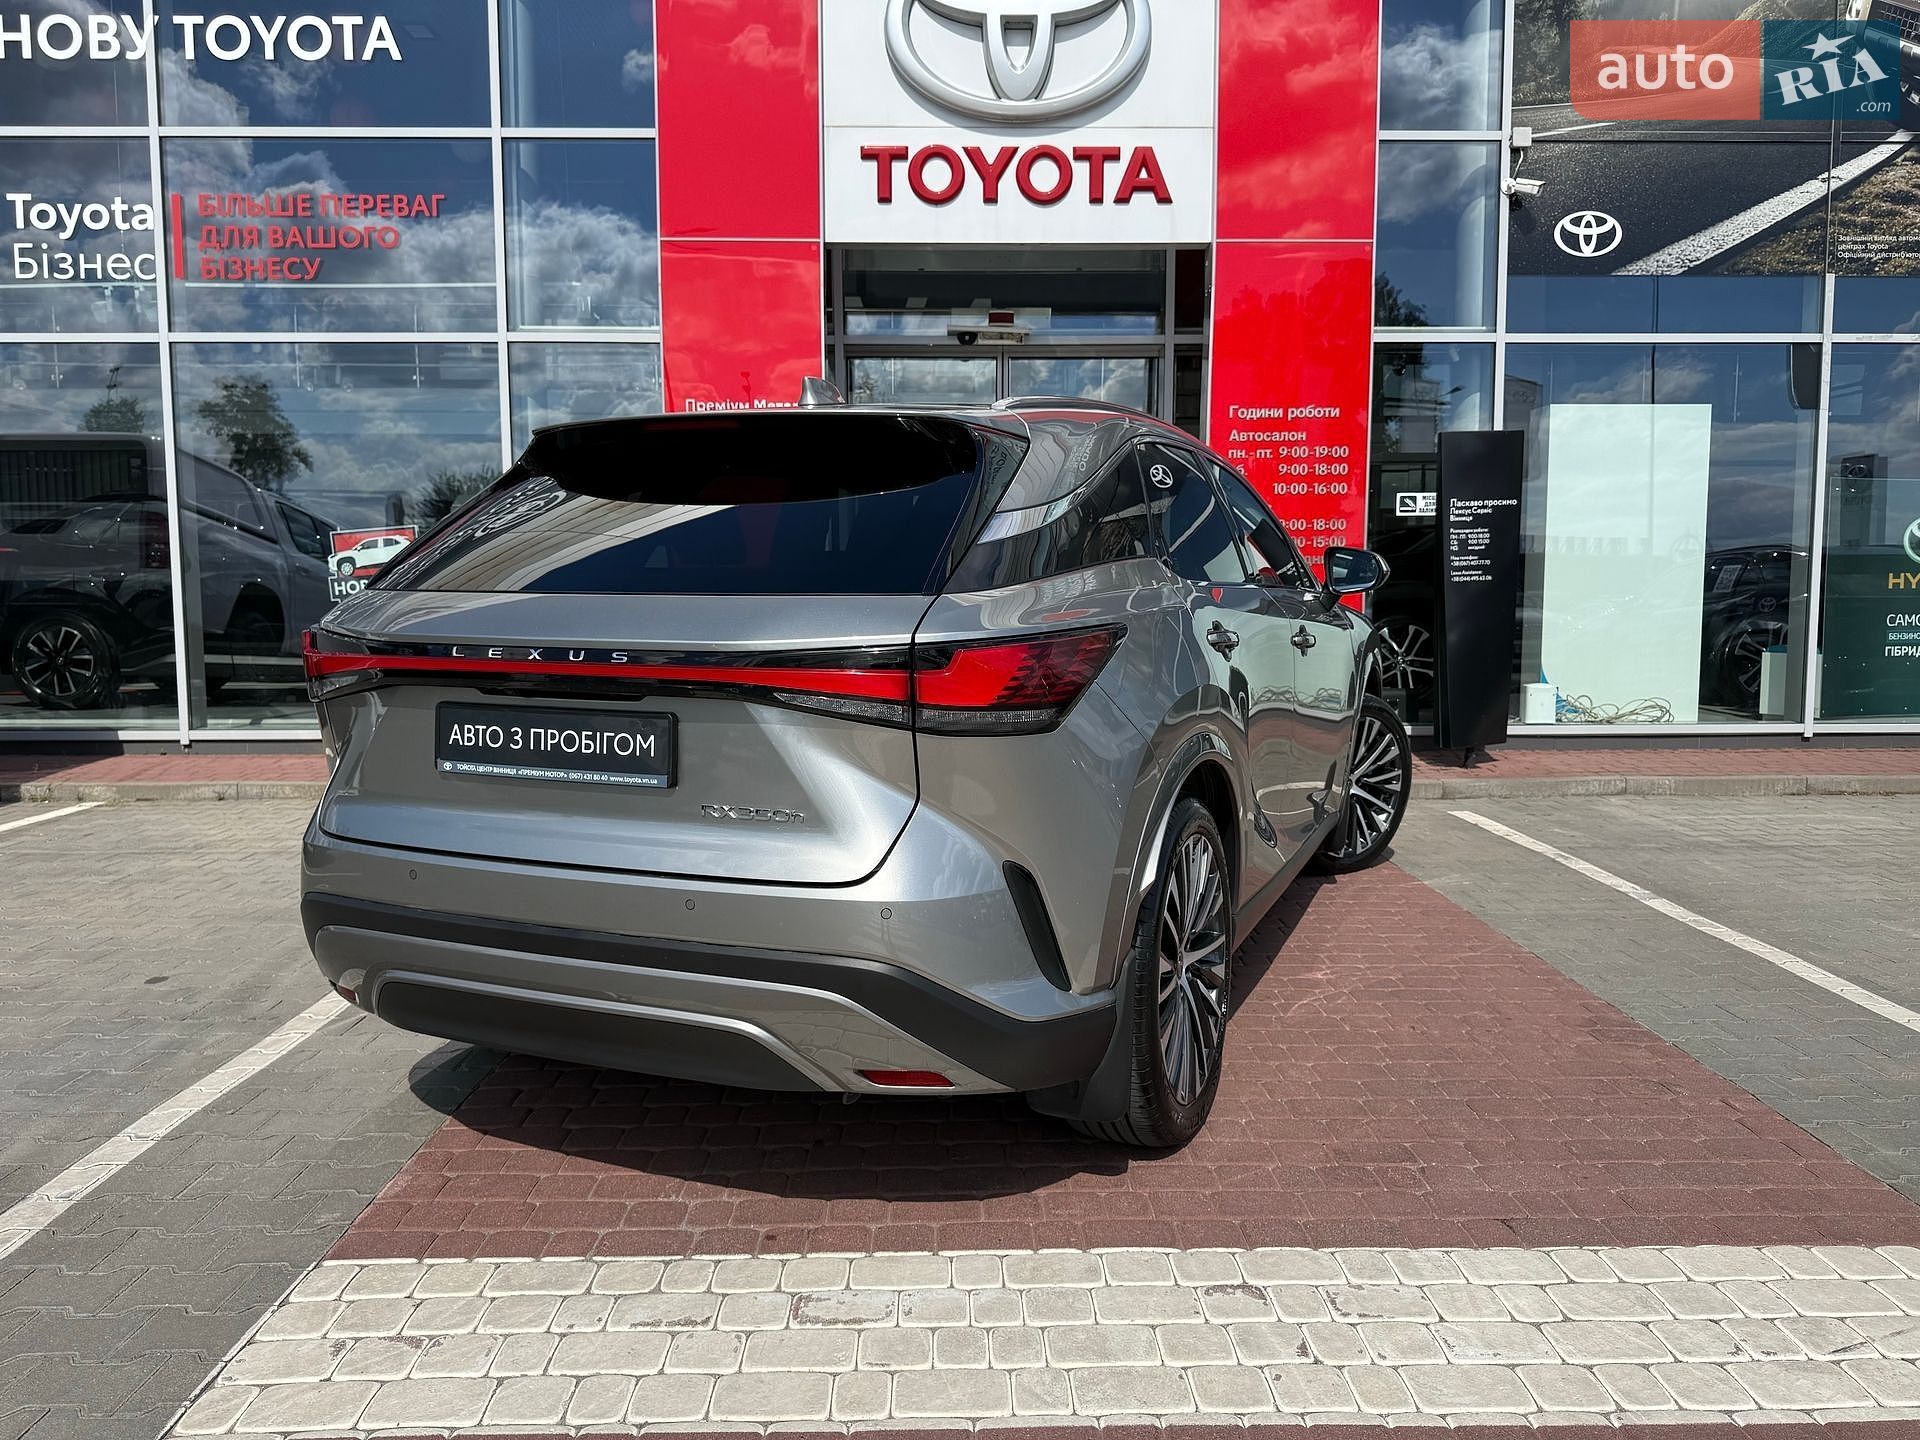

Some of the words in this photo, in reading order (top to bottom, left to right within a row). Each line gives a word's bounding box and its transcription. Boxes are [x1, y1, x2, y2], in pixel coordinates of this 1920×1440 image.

[172, 15, 402, 61] TOYOTA
[860, 144, 1173, 206] TOYOTA
[6, 193, 154, 240] Toyota
[198, 193, 312, 218] БІЛЬШЕ
[318, 193, 446, 218] ПЕРЕВАГ
[198, 225, 260, 252] ДЛЯ
[267, 225, 400, 249] ВАШОГО
[13, 243, 157, 280] Бізнес
[201, 256, 321, 280] БІЗНЕСУ
[1229, 405, 1283, 420] Години
[1287, 404, 1340, 421] роботи
[1229, 429, 1307, 442] Автосалон
[1278, 446, 1349, 458] 9:00-19:00
[1278, 463, 1348, 476] 9:00-18:00
[1272, 482, 1348, 495] 10:00-16:00
[1888, 572, 1920, 590] HY
[451, 645, 629, 664] LEXUS
[449, 723, 504, 748] АВТО
[509, 727, 523, 750] З
[530, 728, 656, 758] ПРОБІГОМ
